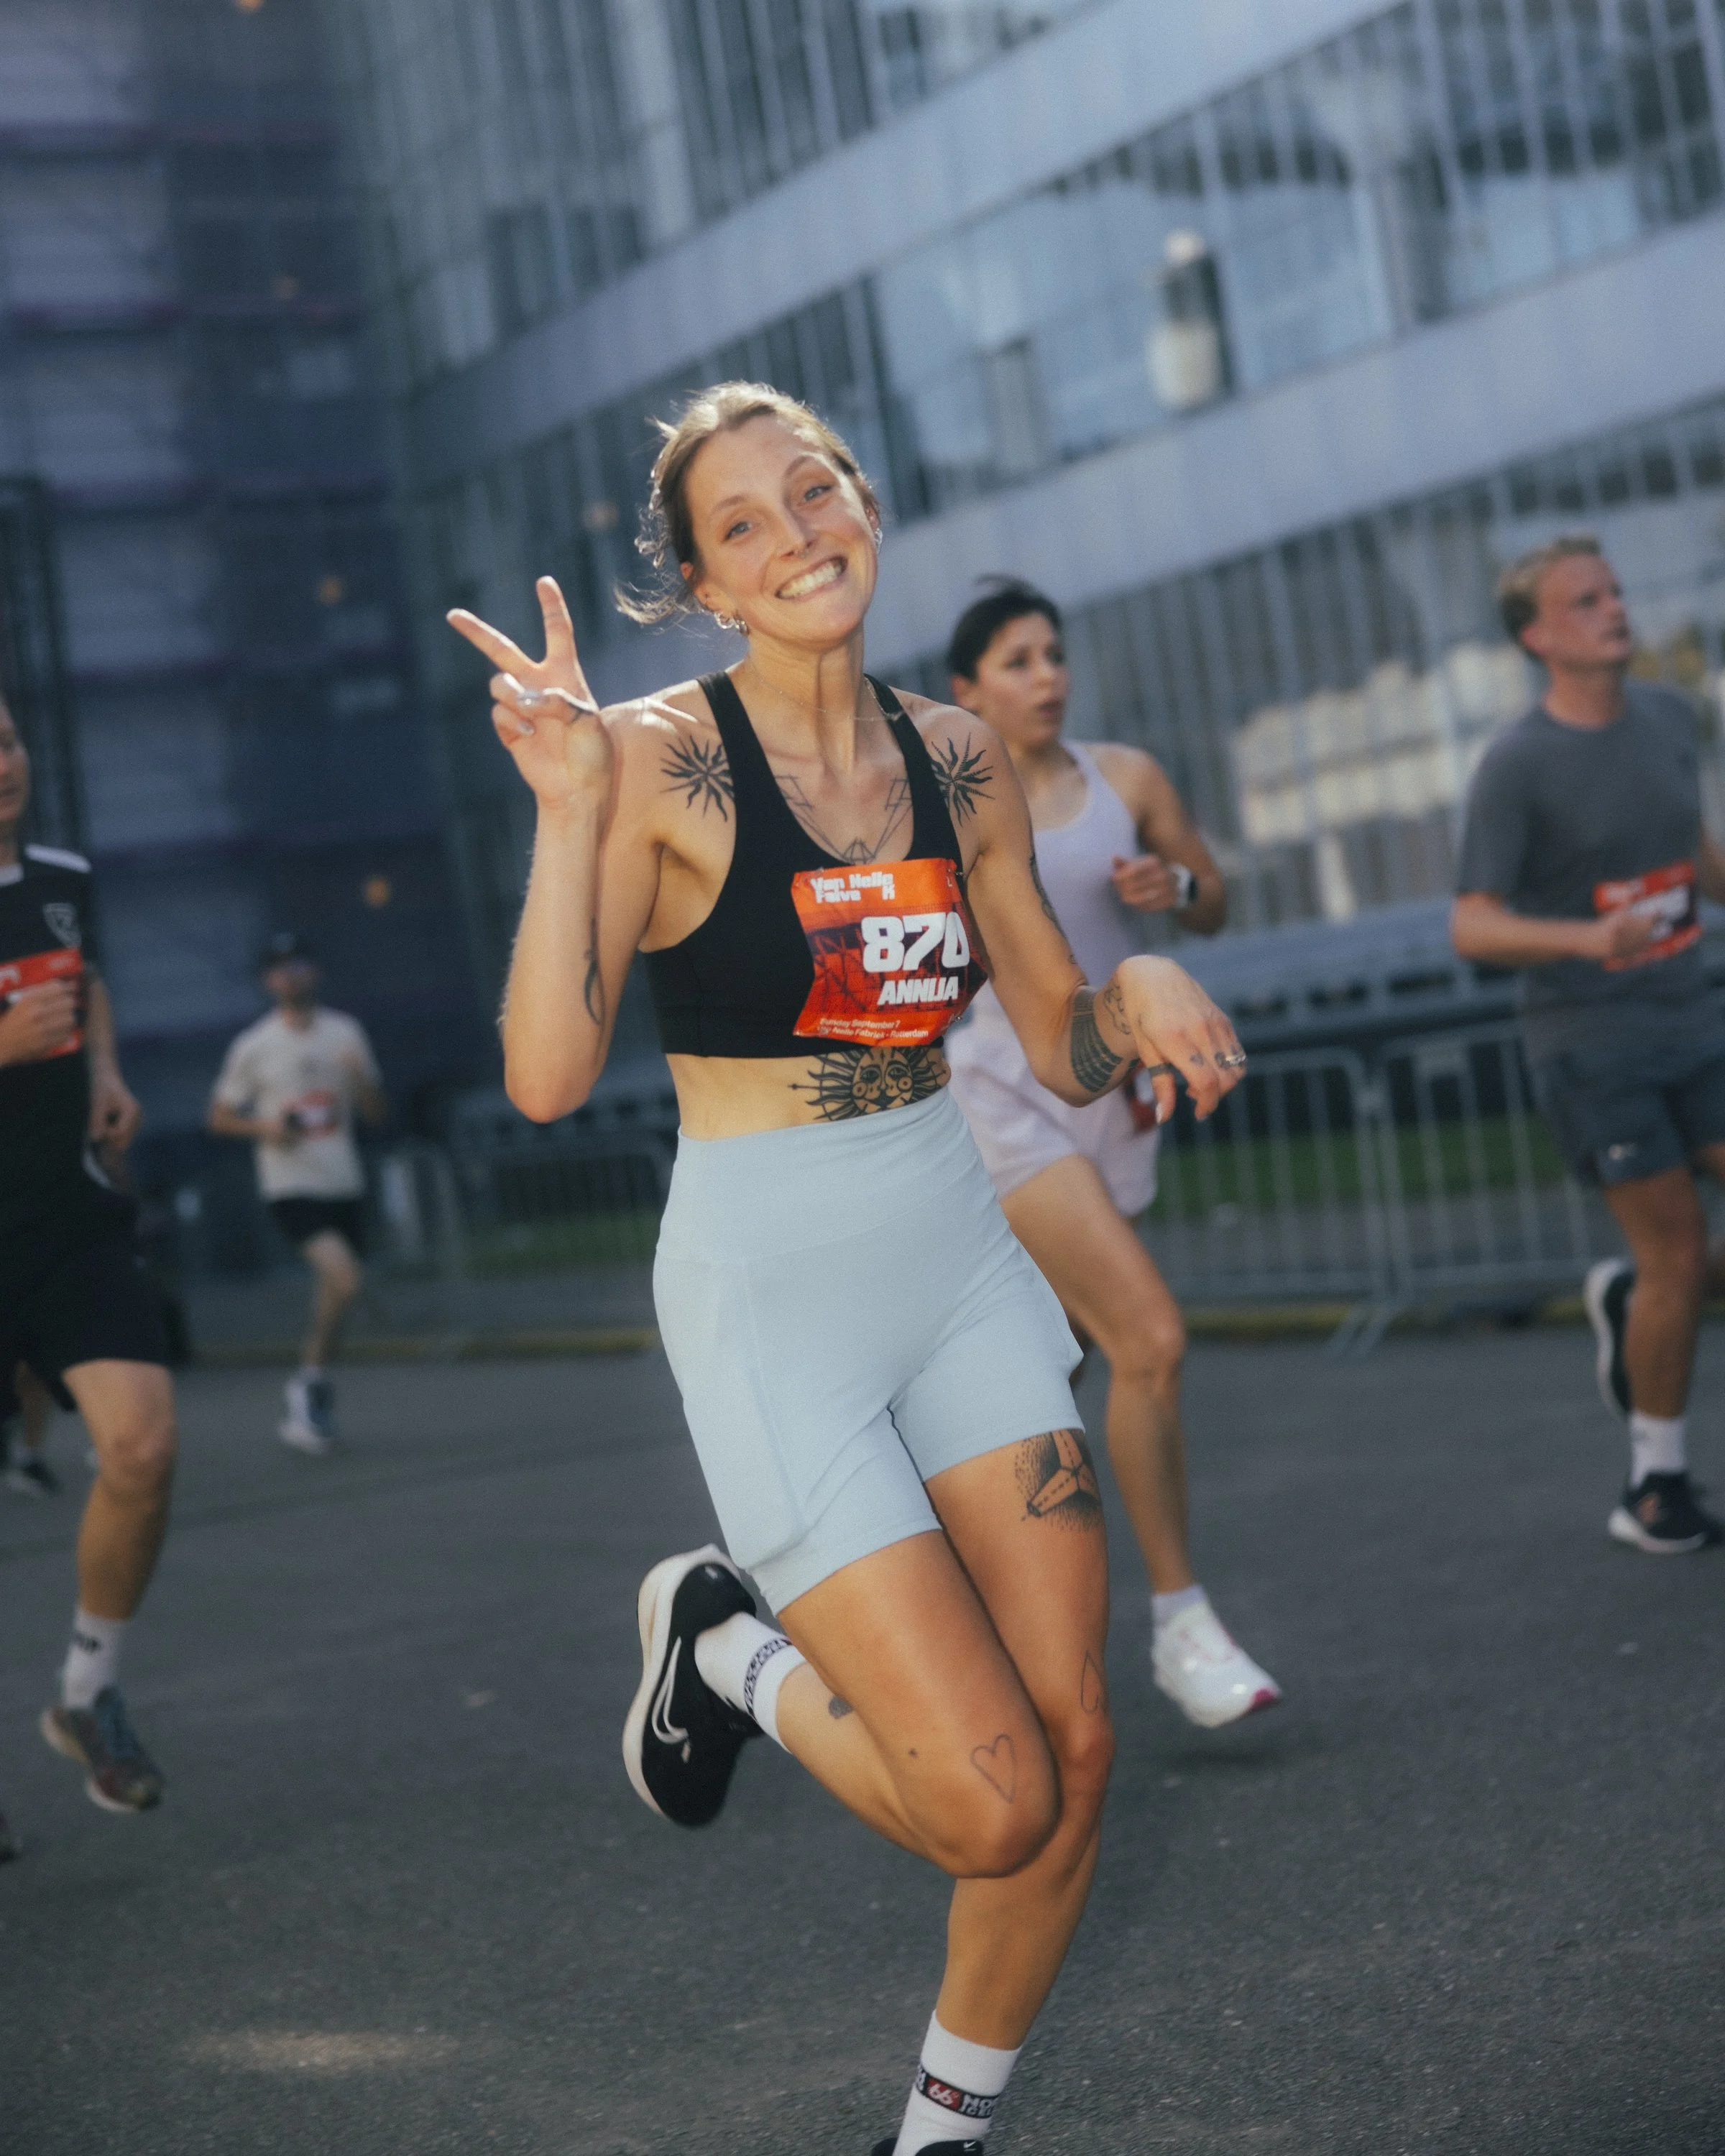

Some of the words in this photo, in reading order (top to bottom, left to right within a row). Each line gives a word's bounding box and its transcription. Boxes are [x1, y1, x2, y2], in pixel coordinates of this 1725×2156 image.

[850, 871, 893, 888] Nelle
[861, 911, 970, 973] 870
[852, 1019, 894, 1029] September
[890, 1029, 929, 1038] Rotterdam
